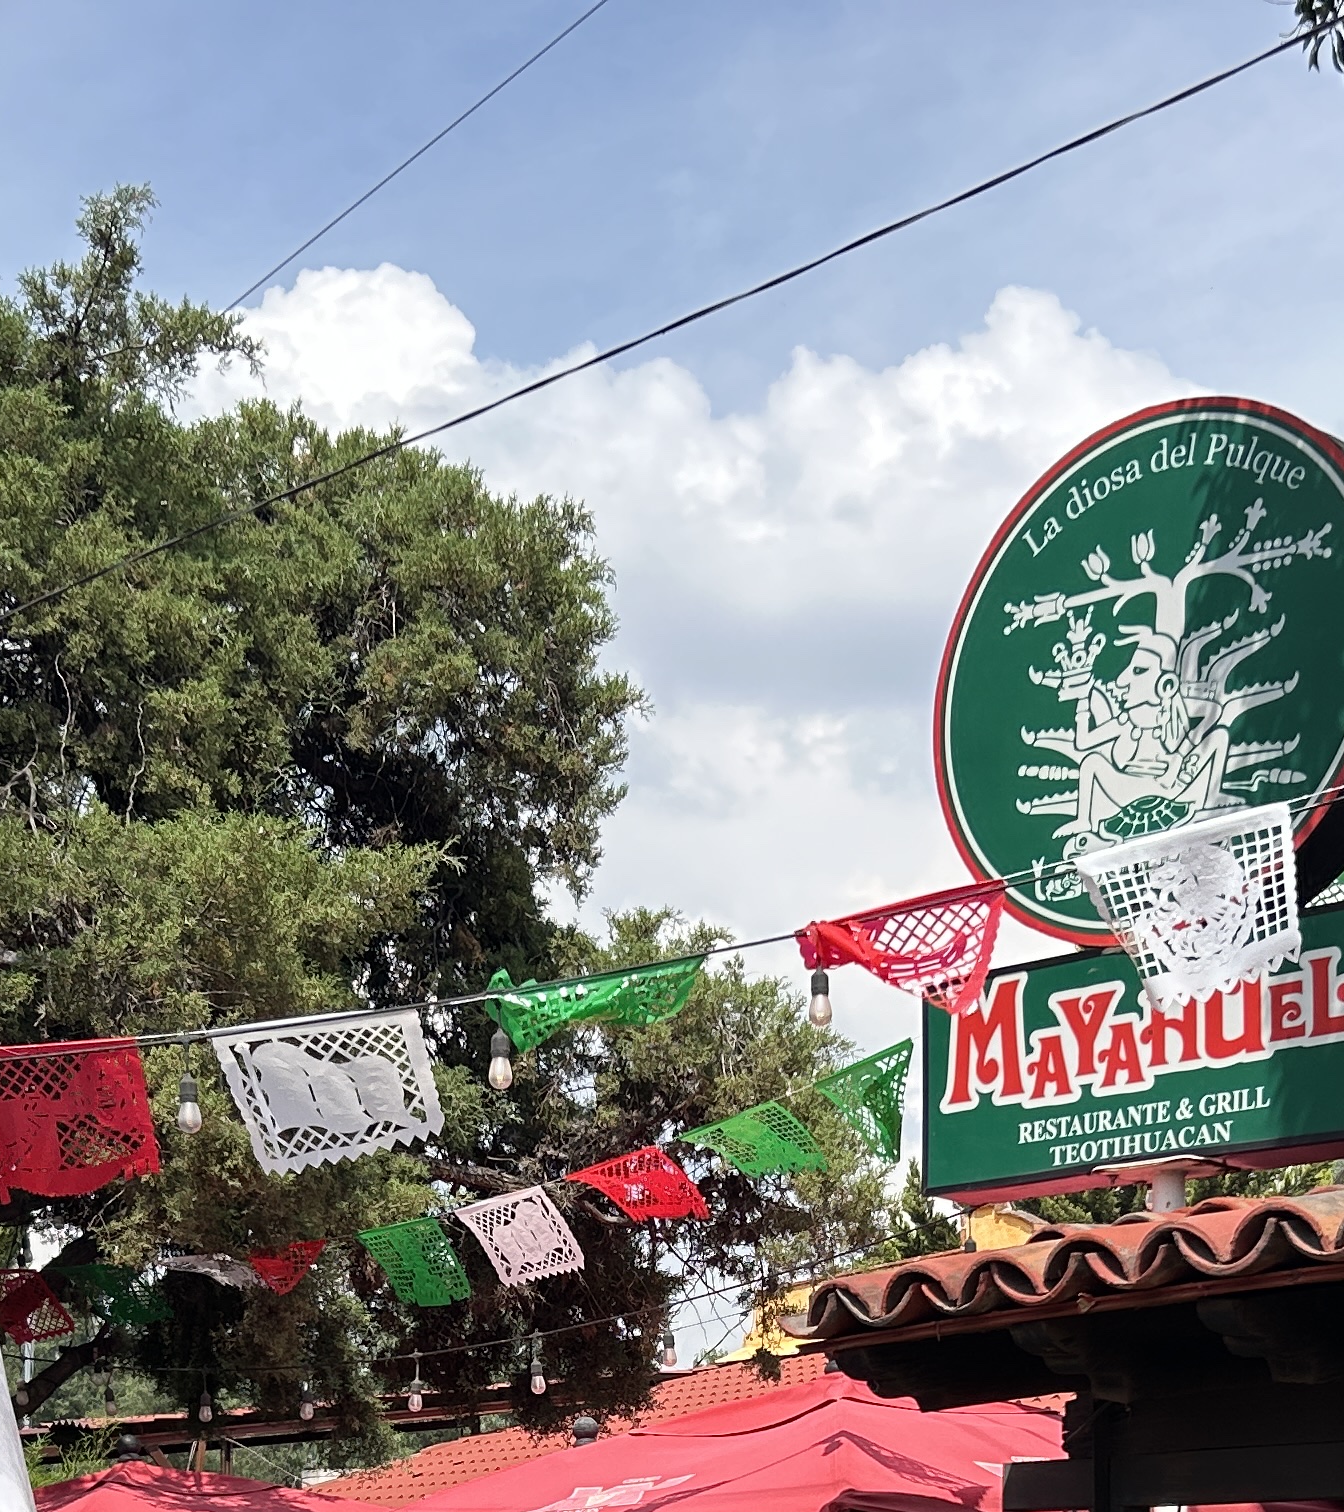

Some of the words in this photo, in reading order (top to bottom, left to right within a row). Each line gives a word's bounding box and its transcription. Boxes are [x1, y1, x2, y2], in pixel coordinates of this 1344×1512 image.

[1021, 516, 1064, 558] La
[1065, 458, 1144, 520] diosa
[1150, 432, 1198, 474] del
[1203, 433, 1307, 490] Pulque
[1017, 1100, 1171, 1145] RESTAURANTE
[1175, 1099, 1194, 1121] &
[1198, 1085, 1272, 1117] GRILL
[1049, 1119, 1234, 1167] TEOTIHUACAN
